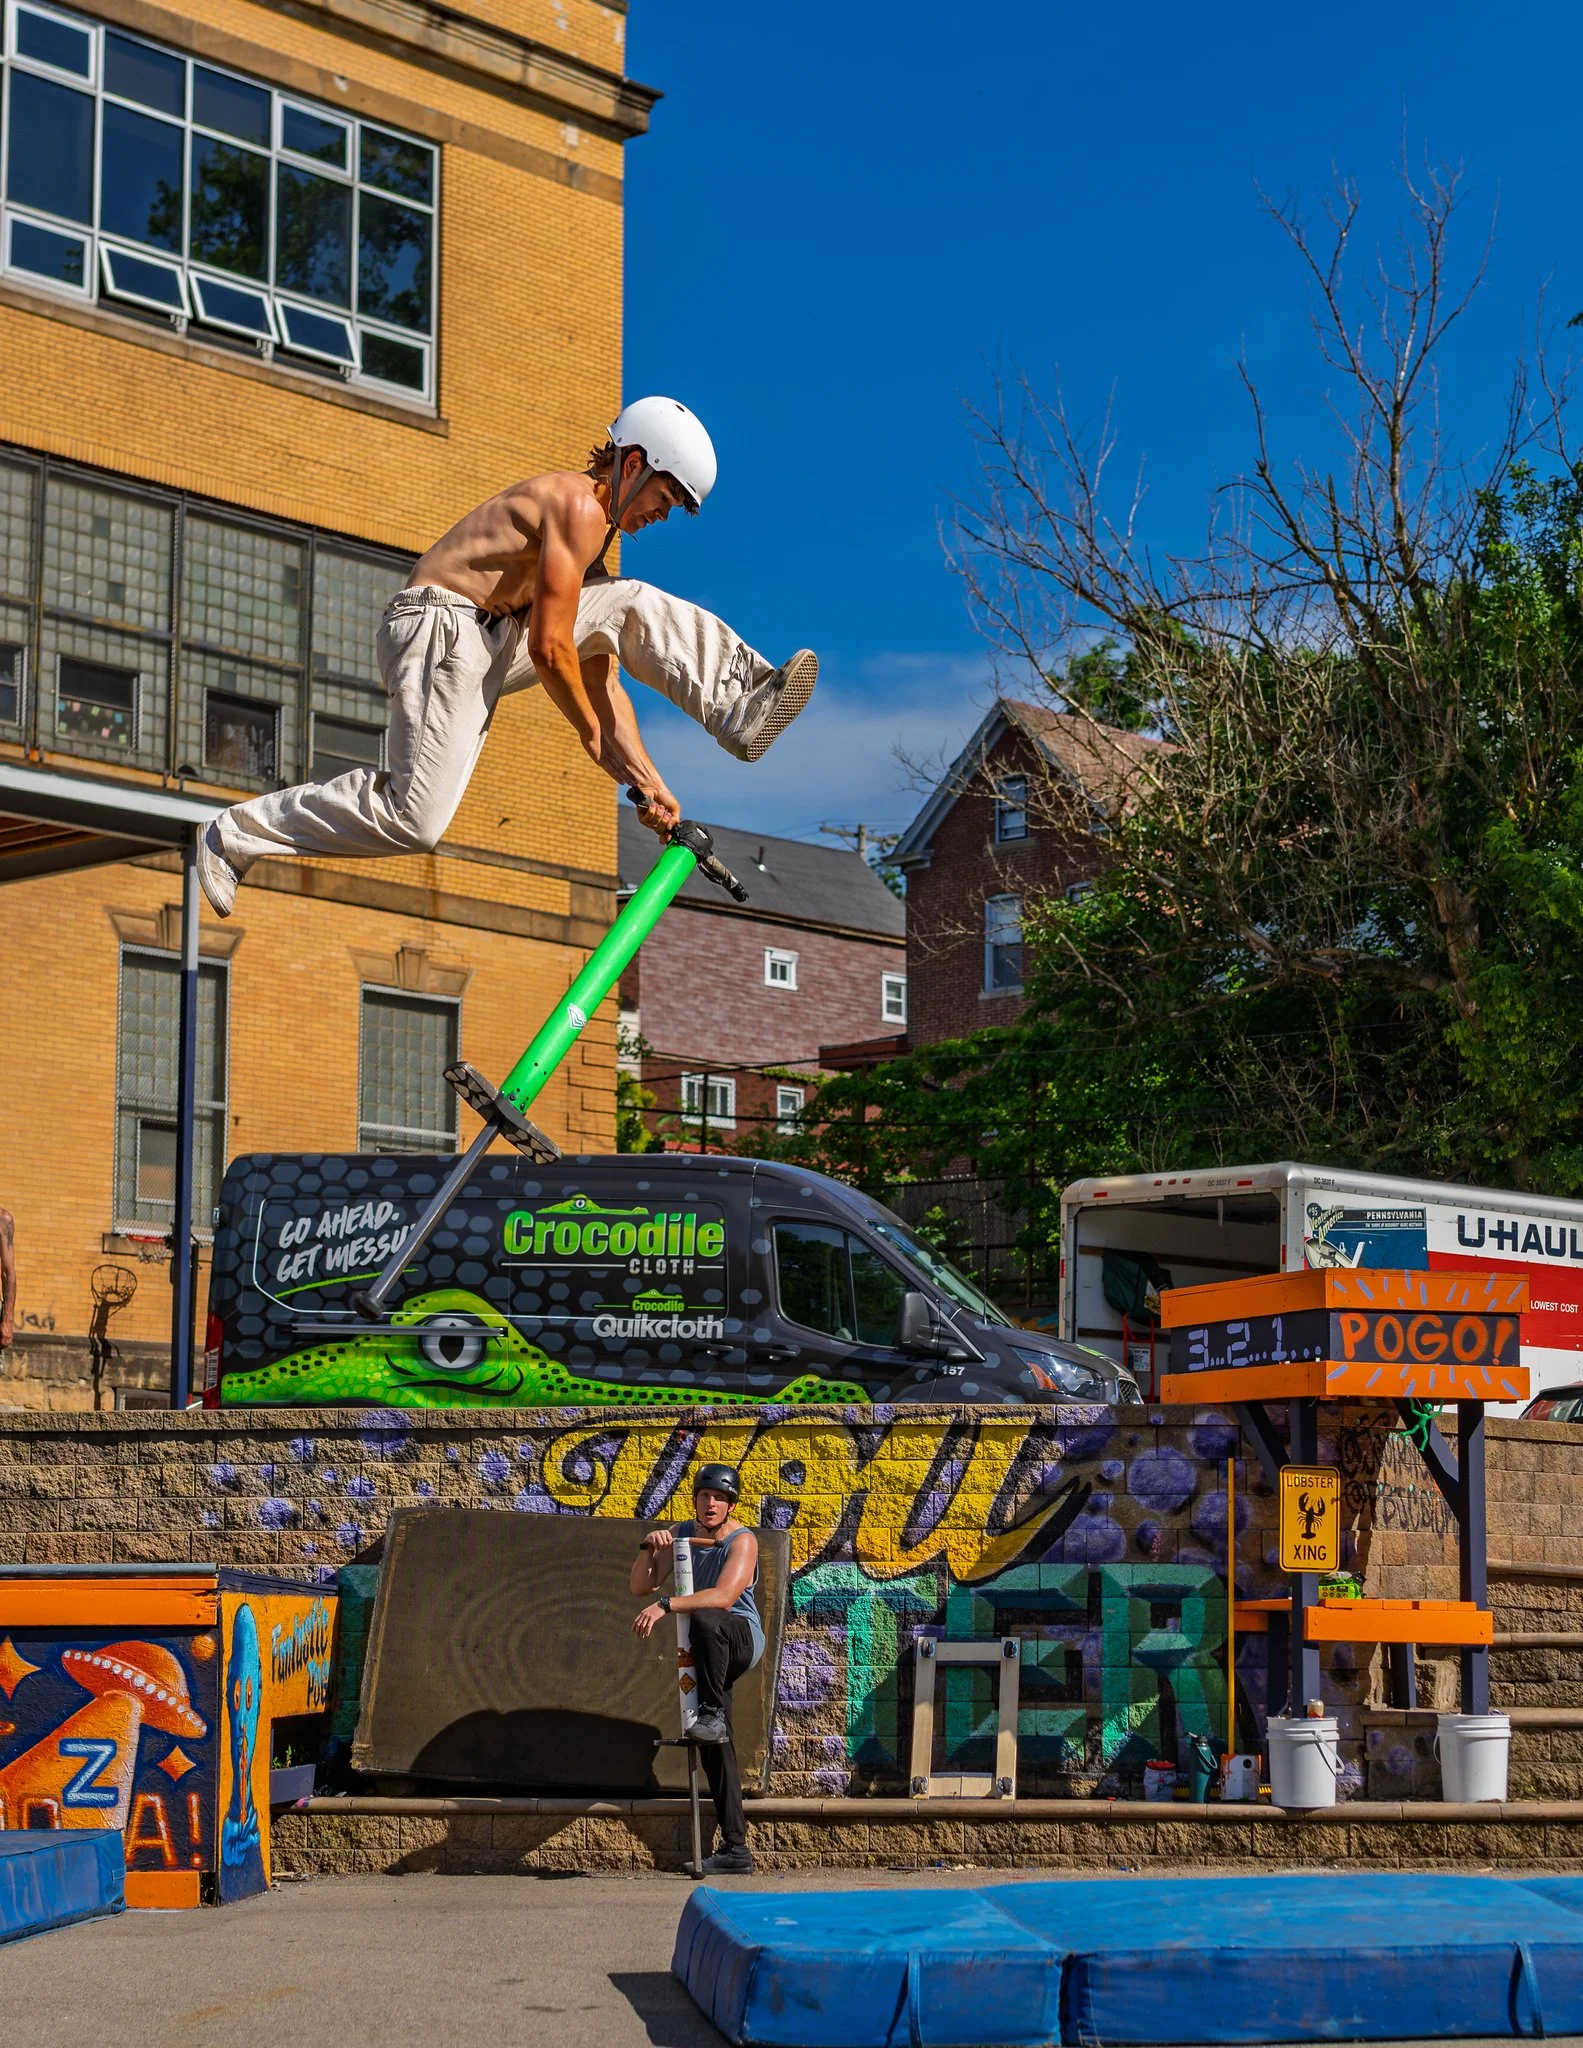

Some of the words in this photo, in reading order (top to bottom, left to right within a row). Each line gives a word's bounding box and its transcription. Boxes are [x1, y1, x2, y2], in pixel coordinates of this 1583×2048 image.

[278, 1217, 311, 1249] GO
[316, 1201, 400, 1239] AHEAD.
[1366, 1211, 1423, 1220] PENNSYLVANIA
[503, 1210, 725, 1258] Crocodile
[1457, 1214, 1583, 1260] U-HAUL
[276, 1244, 323, 1283] GET
[629, 1258, 695, 1275] CLOTH
[632, 1299, 685, 1312] Crocodile
[1530, 1300, 1558, 1312] LOWEST
[1560, 1303, 1579, 1314] COST
[592, 1313, 725, 1339] Quikcloth
[1339, 1312, 1513, 1365] POGO!
[1286, 1475, 1334, 1489] LOBSTER
[1293, 1544, 1327, 1561] XING
